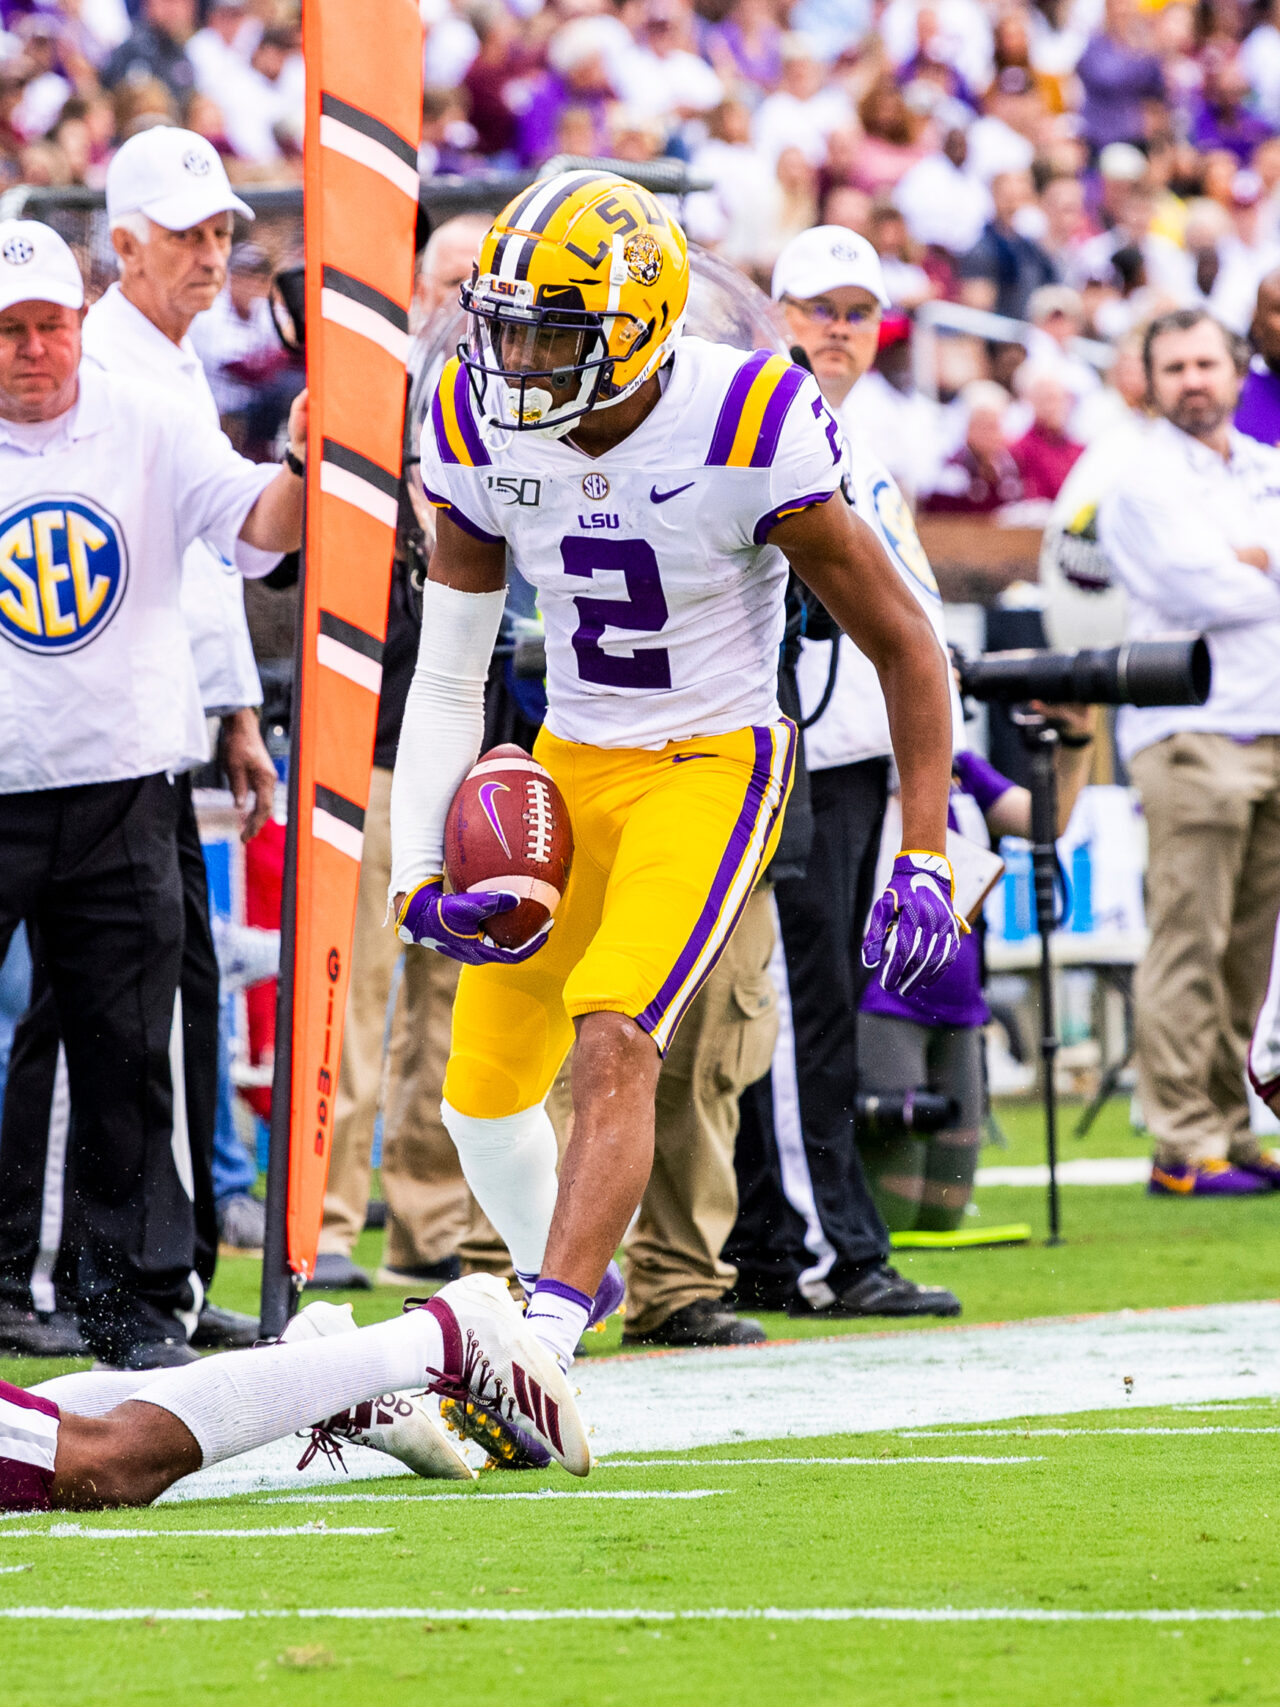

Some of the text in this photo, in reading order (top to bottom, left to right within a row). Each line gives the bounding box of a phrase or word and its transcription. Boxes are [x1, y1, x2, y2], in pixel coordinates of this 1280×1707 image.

[565, 192, 665, 270] LSU
[489, 278, 519, 297] LSU
[487, 476, 541, 506] 150
[583, 473, 608, 499] SEC
[577, 513, 620, 530] LSU
[560, 535, 672, 689] 2
